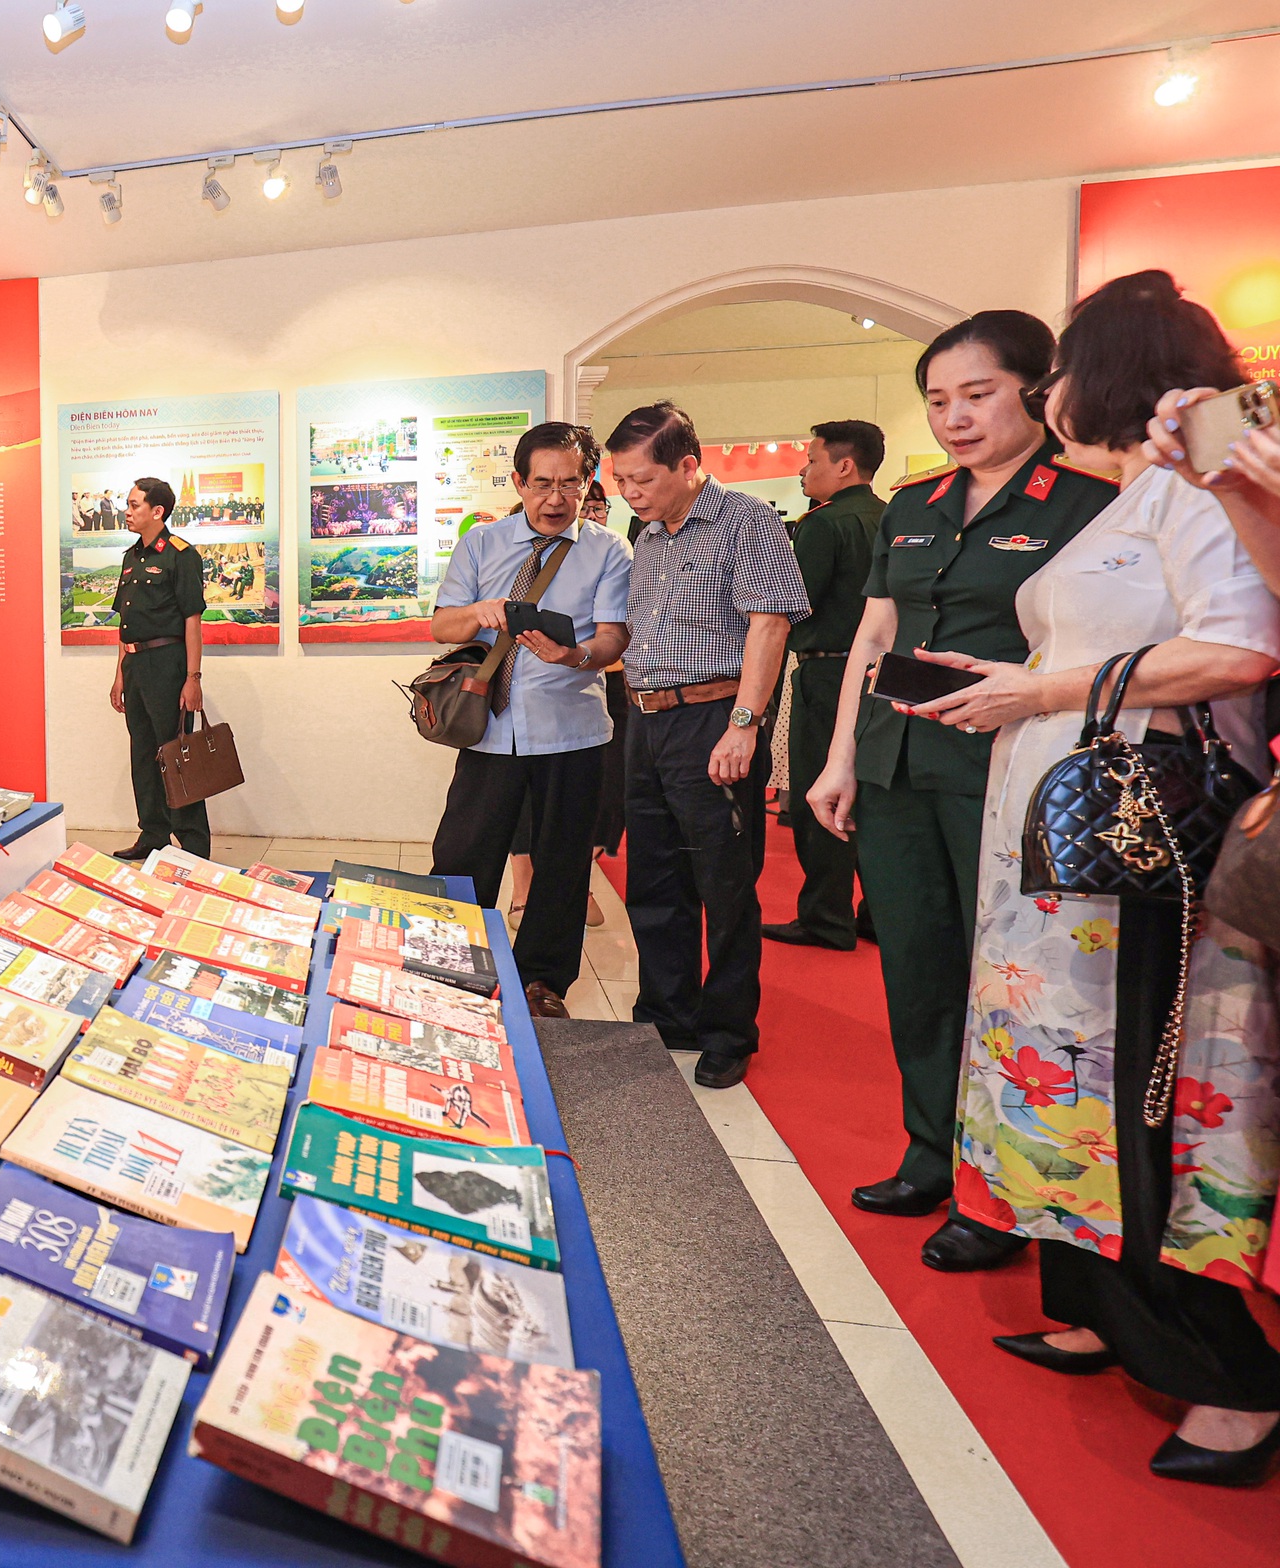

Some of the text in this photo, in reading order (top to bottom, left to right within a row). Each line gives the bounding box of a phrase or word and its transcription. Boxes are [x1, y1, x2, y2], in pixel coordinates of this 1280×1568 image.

[71, 412, 91, 423] ĐIỆN
[94, 410, 113, 420] BIÊN
[140, 408, 158, 416] NAY
[18, 1208, 80, 1260] 308
[297, 1353, 362, 1455] Điện
